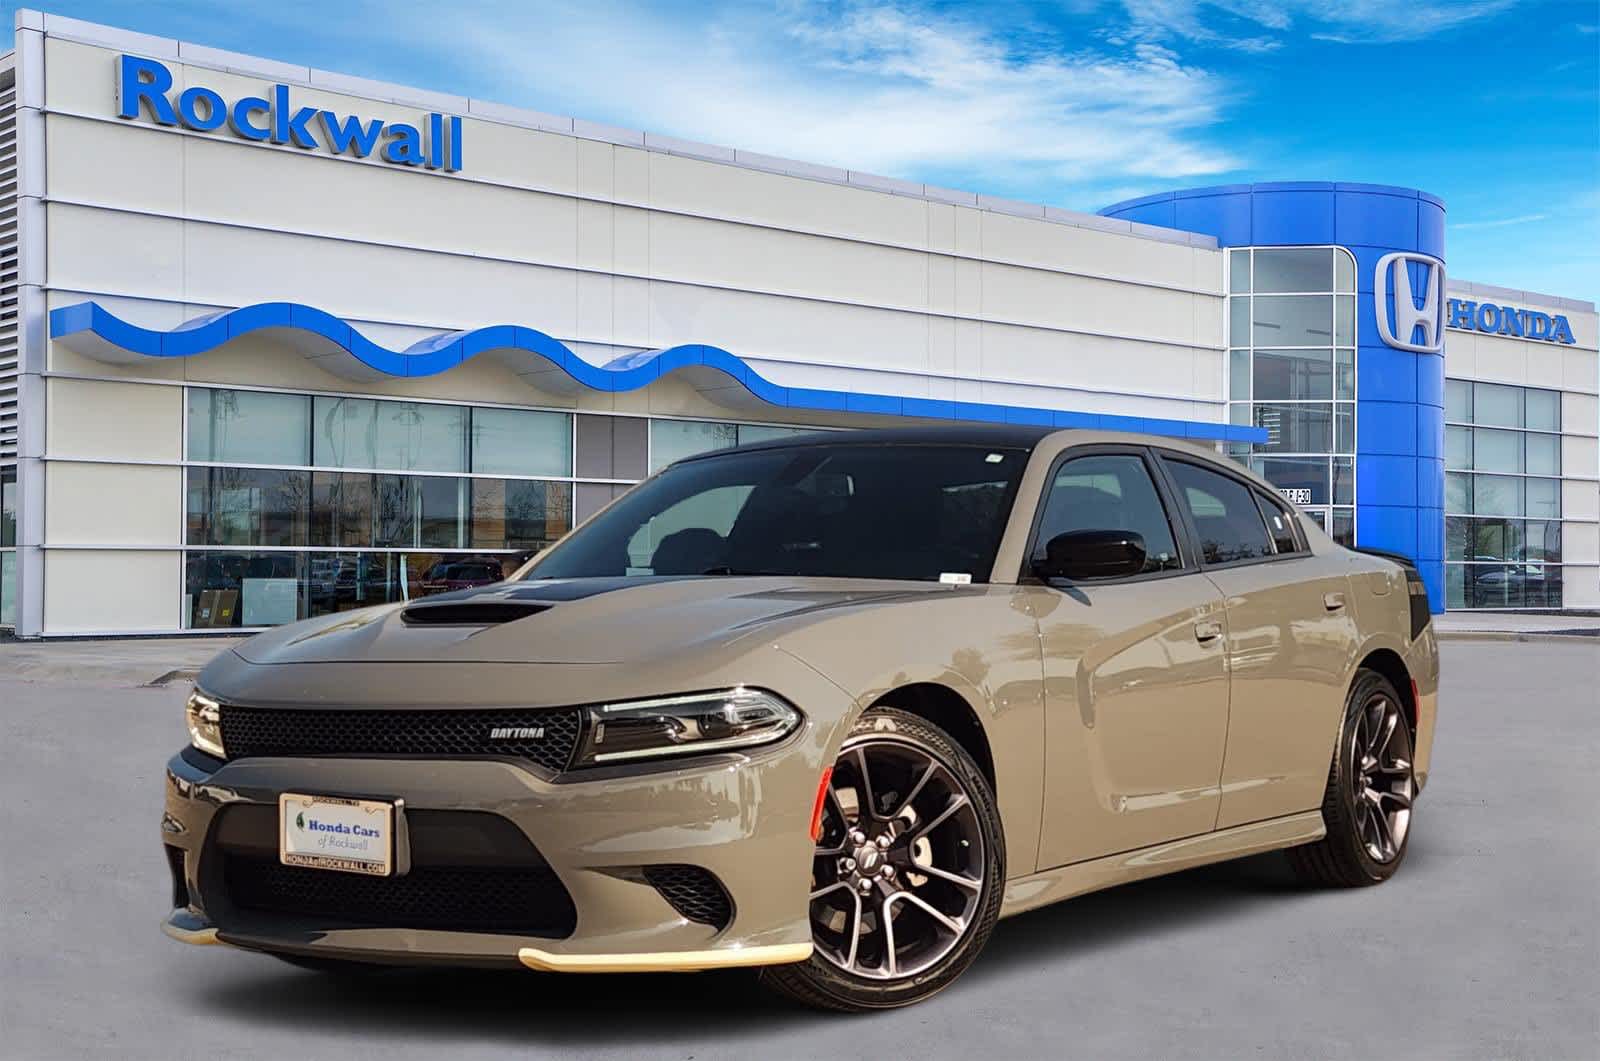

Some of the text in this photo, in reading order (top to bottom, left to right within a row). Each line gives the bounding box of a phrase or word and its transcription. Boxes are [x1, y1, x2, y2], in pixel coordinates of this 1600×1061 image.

[117, 53, 464, 173] Rockwall
[1448, 298, 1577, 344] HONDA
[490, 727, 545, 739] DAYTONA
[309, 820, 381, 838] Honda Cars
[328, 836, 369, 850] Rockwall
